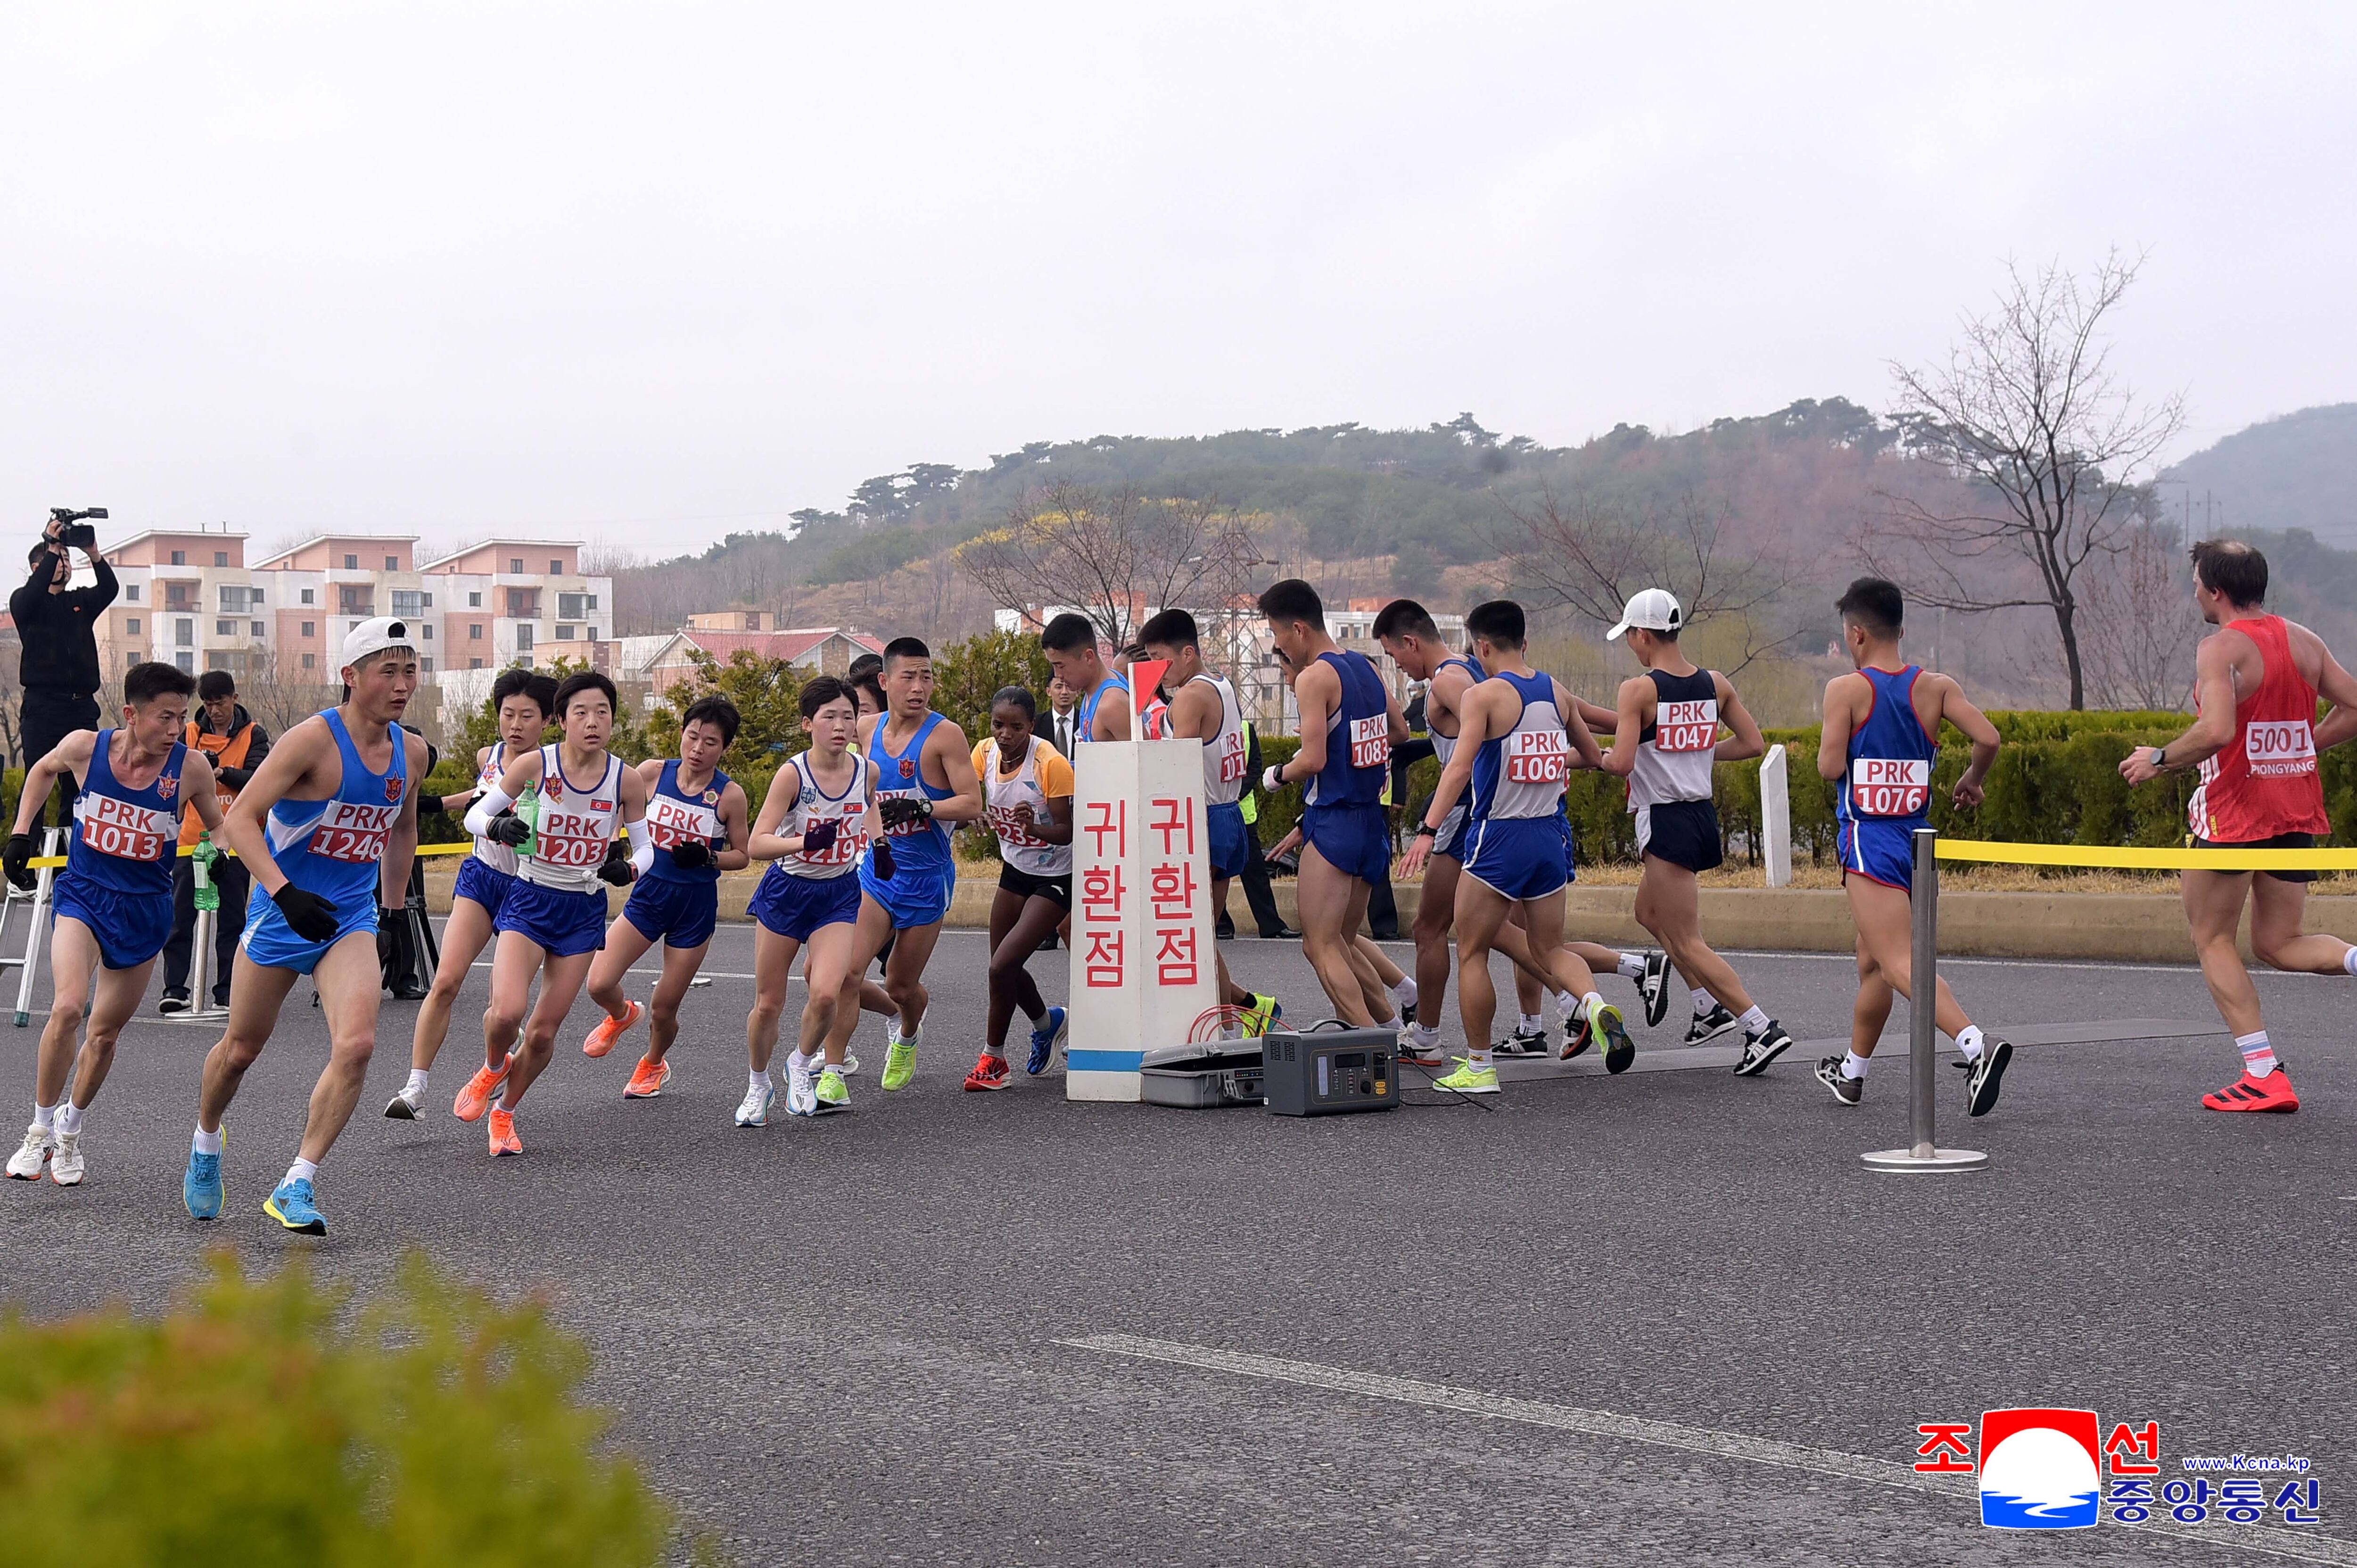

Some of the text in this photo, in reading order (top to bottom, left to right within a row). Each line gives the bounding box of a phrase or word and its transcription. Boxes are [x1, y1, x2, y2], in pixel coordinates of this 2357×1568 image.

[1669, 702, 1707, 723] PRK
[1360, 716, 1385, 740] PRK
[1659, 725, 1713, 750] 1047
[2250, 727, 2309, 753] 5001
[1353, 738, 1389, 767] 1083
[1521, 732, 1561, 753] PRK
[1511, 756, 1565, 781] 1062
[1867, 761, 1915, 783] PRK
[1858, 787, 1922, 813] 1076
[97, 797, 157, 832] PRK
[334, 805, 395, 830] PRK
[547, 814, 602, 838] PRK
[657, 803, 704, 833] PRK
[85, 821, 158, 859] 1013
[313, 830, 386, 861] 1246
[536, 836, 602, 865] 1203
[1081, 799, 1127, 988] 귀환점
[1150, 796, 1198, 986] 귀환점
